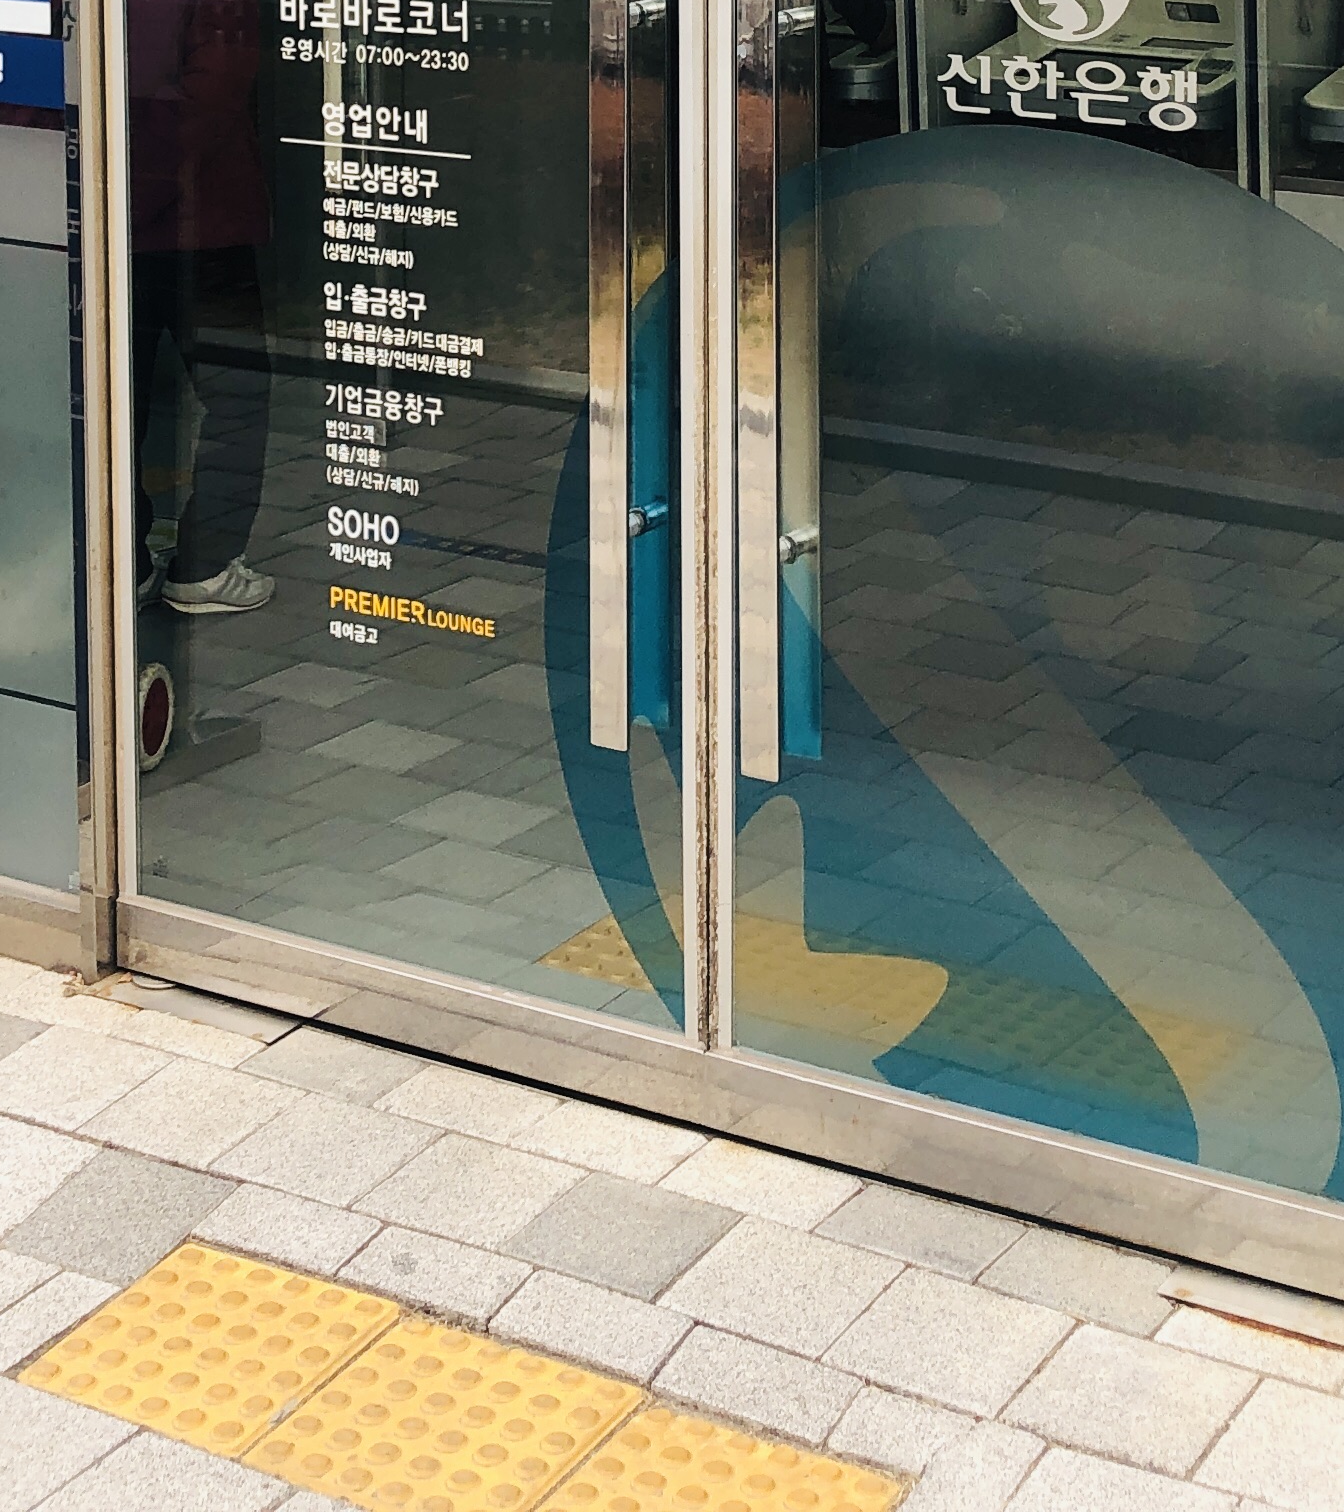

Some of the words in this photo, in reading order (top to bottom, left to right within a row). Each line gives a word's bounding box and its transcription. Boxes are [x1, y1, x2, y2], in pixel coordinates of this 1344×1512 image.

[280, 37, 348, 64] 운영시간
[355, 44, 470, 72] 07:00~23:30
[937, 53, 1198, 132] 신한은행
[321, 102, 429, 145] 영업안내
[323, 160, 440, 199] 전문상담창구
[323, 196, 459, 228] 예금/펀드/보험/신용카드
[323, 219, 377, 243] 대출/외환
[323, 241, 415, 270] (상담/신규/해지)
[323, 281, 428, 321] 입·출금창구
[325, 382, 445, 427] 기업금융창구
[325, 419, 375, 444] 법인고객
[325, 443, 381, 469] 대출/외환
[326, 464, 420, 497] (상담/신규/해지)
[327, 505, 400, 546] SOHO
[329, 542, 393, 571] 개인사업자
[329, 585, 426, 626] PREMIER
[427, 608, 496, 639] LOUNGE
[329, 620, 379, 645] 대여금고
